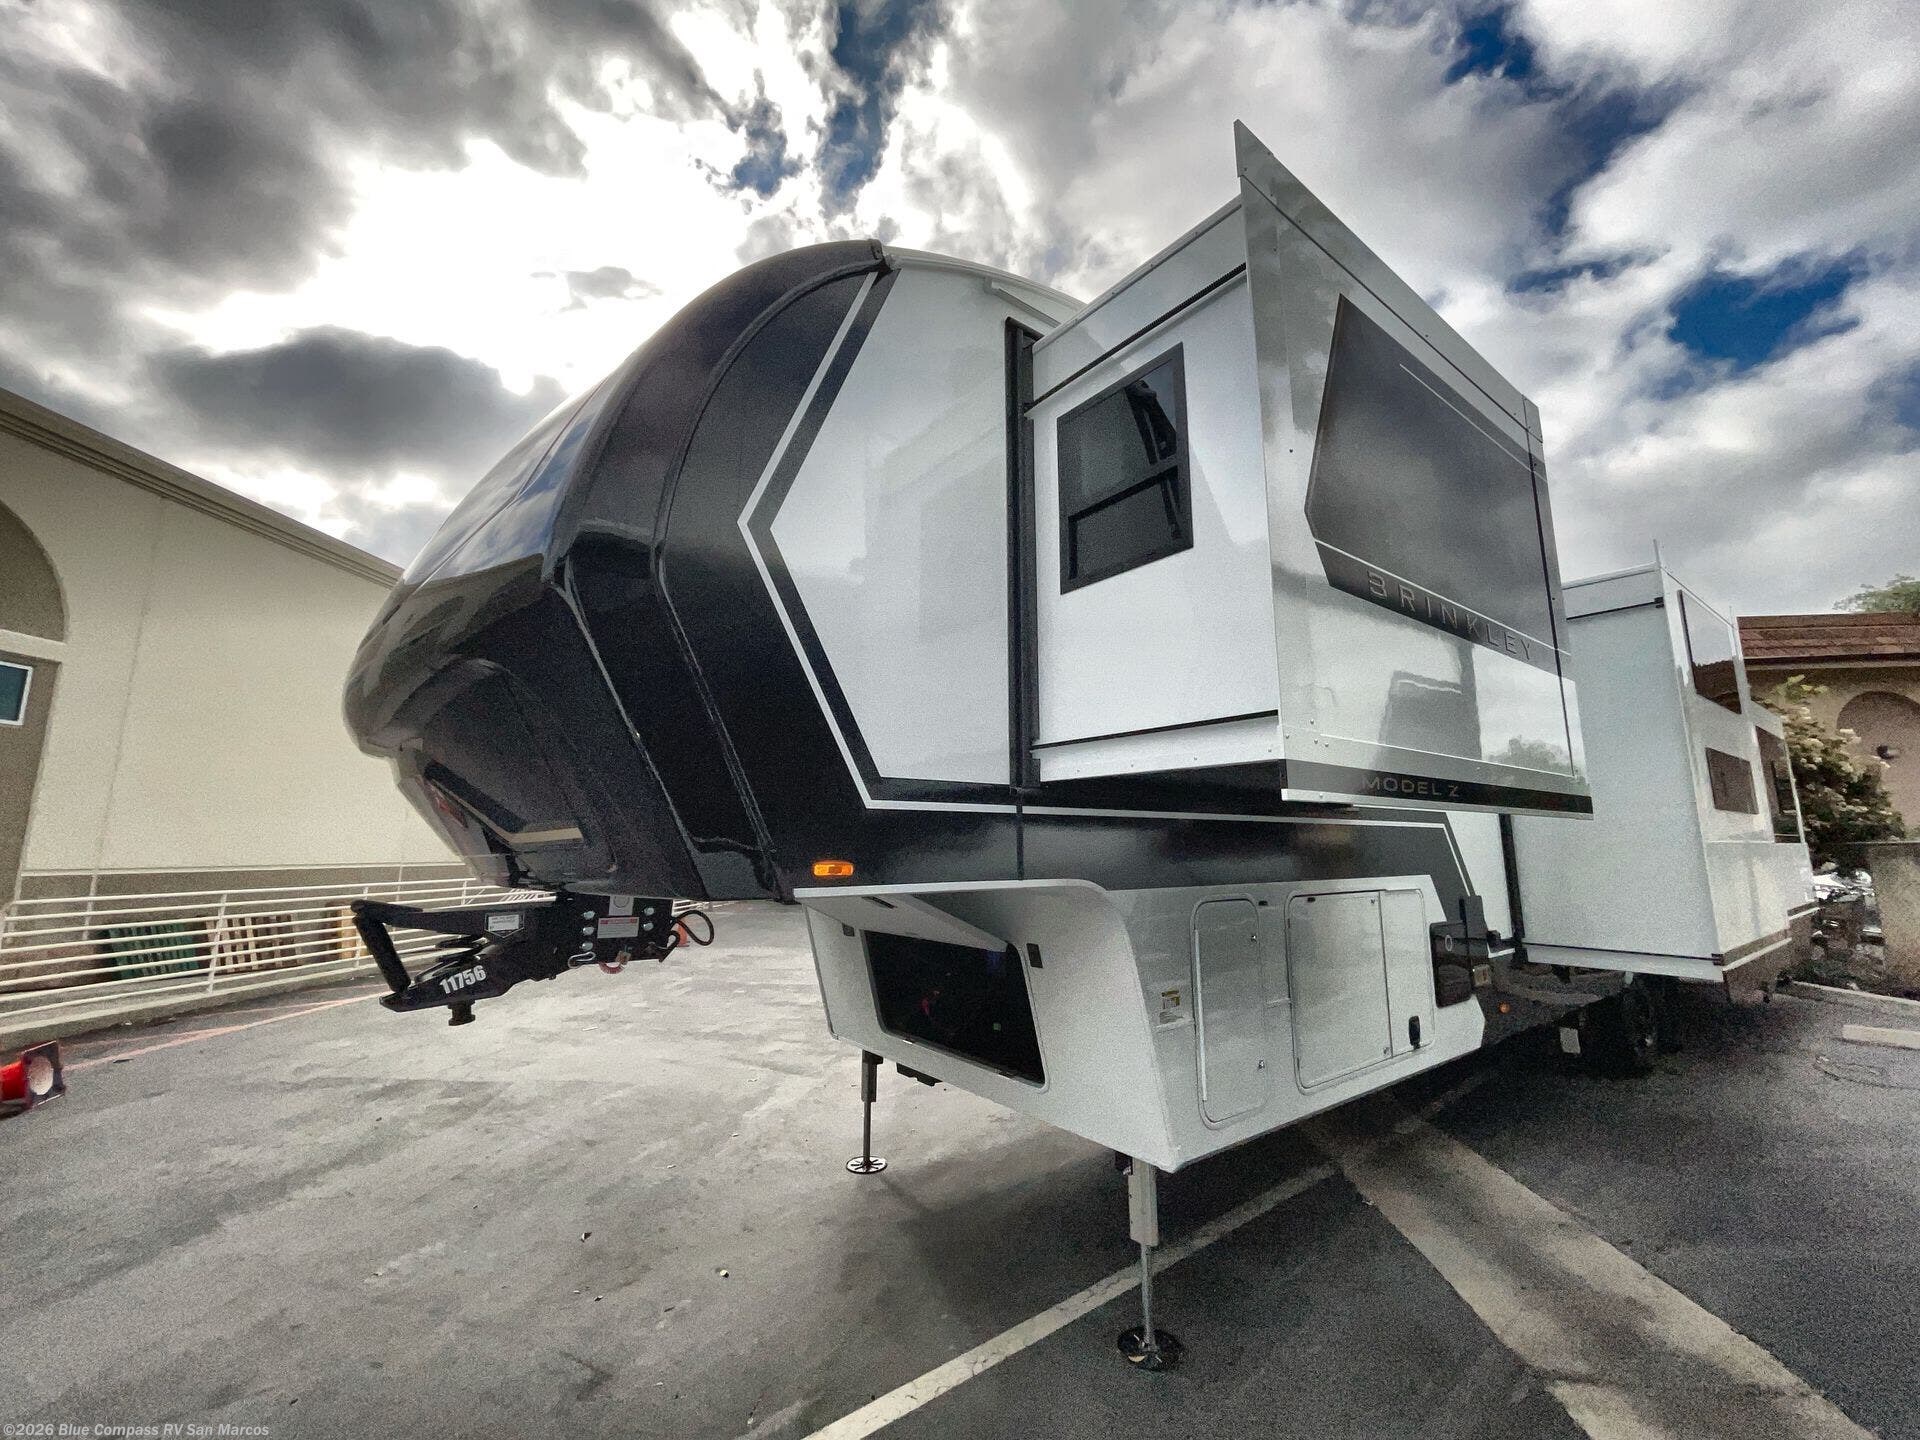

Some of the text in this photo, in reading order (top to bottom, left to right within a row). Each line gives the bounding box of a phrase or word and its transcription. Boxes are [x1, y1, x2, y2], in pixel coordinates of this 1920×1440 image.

[1367, 571, 1532, 660] BRINKLEY
[1361, 774, 1460, 798] MODEL Z
[439, 964, 487, 994] 11756
